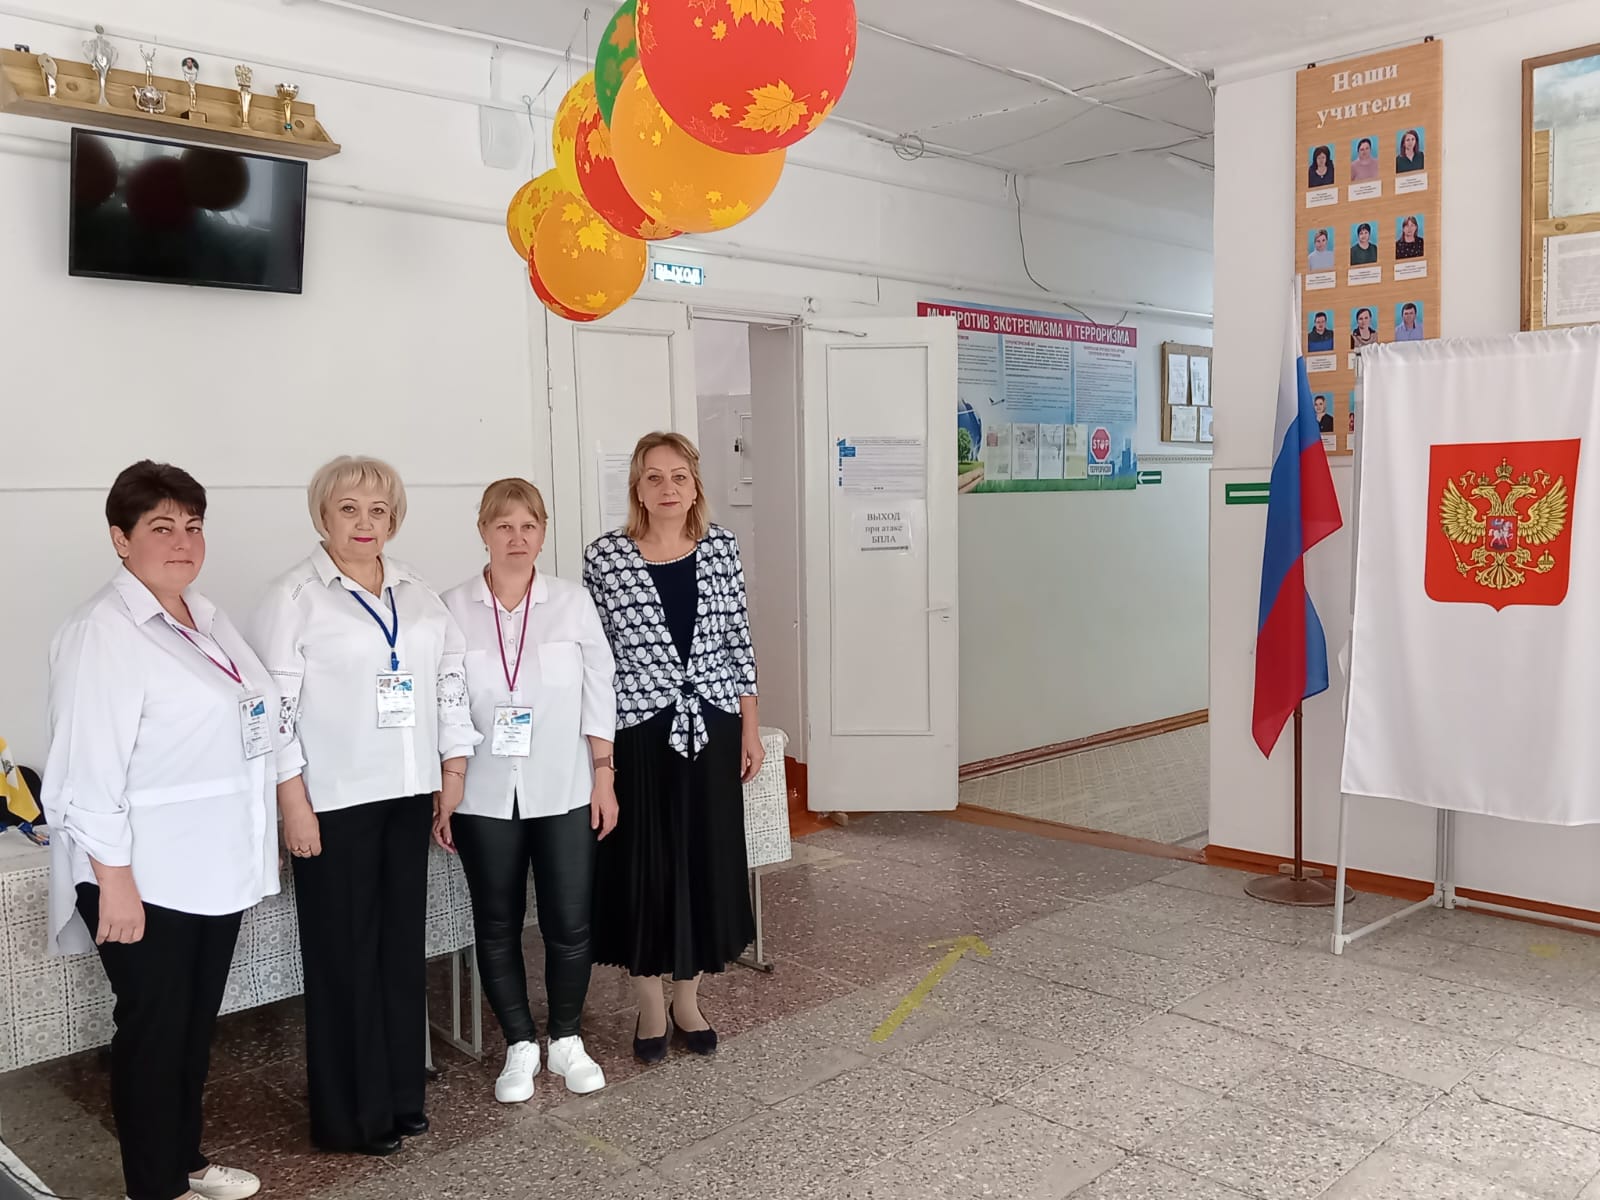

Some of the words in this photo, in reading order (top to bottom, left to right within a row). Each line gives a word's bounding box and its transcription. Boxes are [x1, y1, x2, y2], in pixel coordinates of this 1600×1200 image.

[1331, 63, 1398, 93] Наши
[1316, 92, 1411, 128] учителя
[655, 264, 700, 285] ВЫХОД
[993, 315, 1063, 338] ЭКСТРЕМИЗМА
[1066, 323, 1072, 339] И
[1074, 324, 1130, 345] ТЕРРОРИЗМА
[867, 512, 900, 521] ВЫХОД
[865, 526, 880, 534] при
[872, 535, 896, 544] БПЛА
